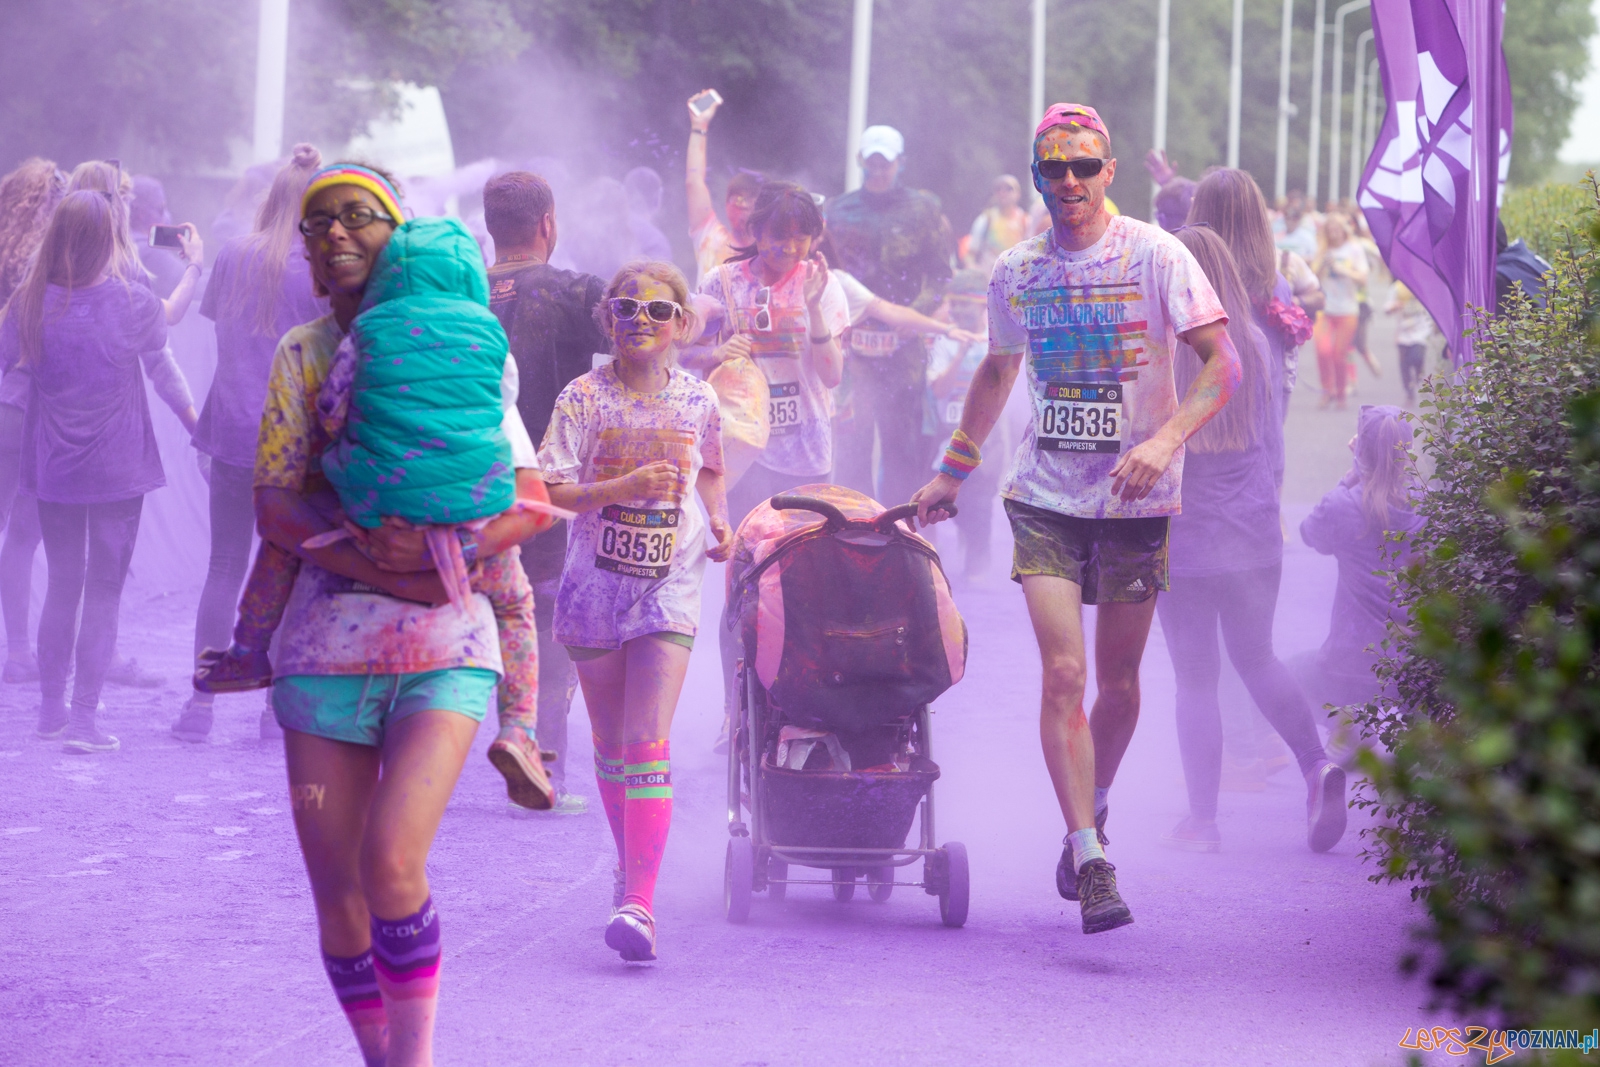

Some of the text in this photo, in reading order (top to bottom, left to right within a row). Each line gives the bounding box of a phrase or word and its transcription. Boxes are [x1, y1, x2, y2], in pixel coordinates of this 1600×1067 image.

[1047, 302, 1093, 325] COLOR
[1093, 301, 1125, 325] RUN
[1049, 387, 1097, 400] THE COLOR RUN
[1042, 404, 1117, 438] 03535
[1058, 440, 1097, 451] #HAPPIEST5K
[602, 526, 673, 563] 03536
[625, 774, 666, 786] COLOR
